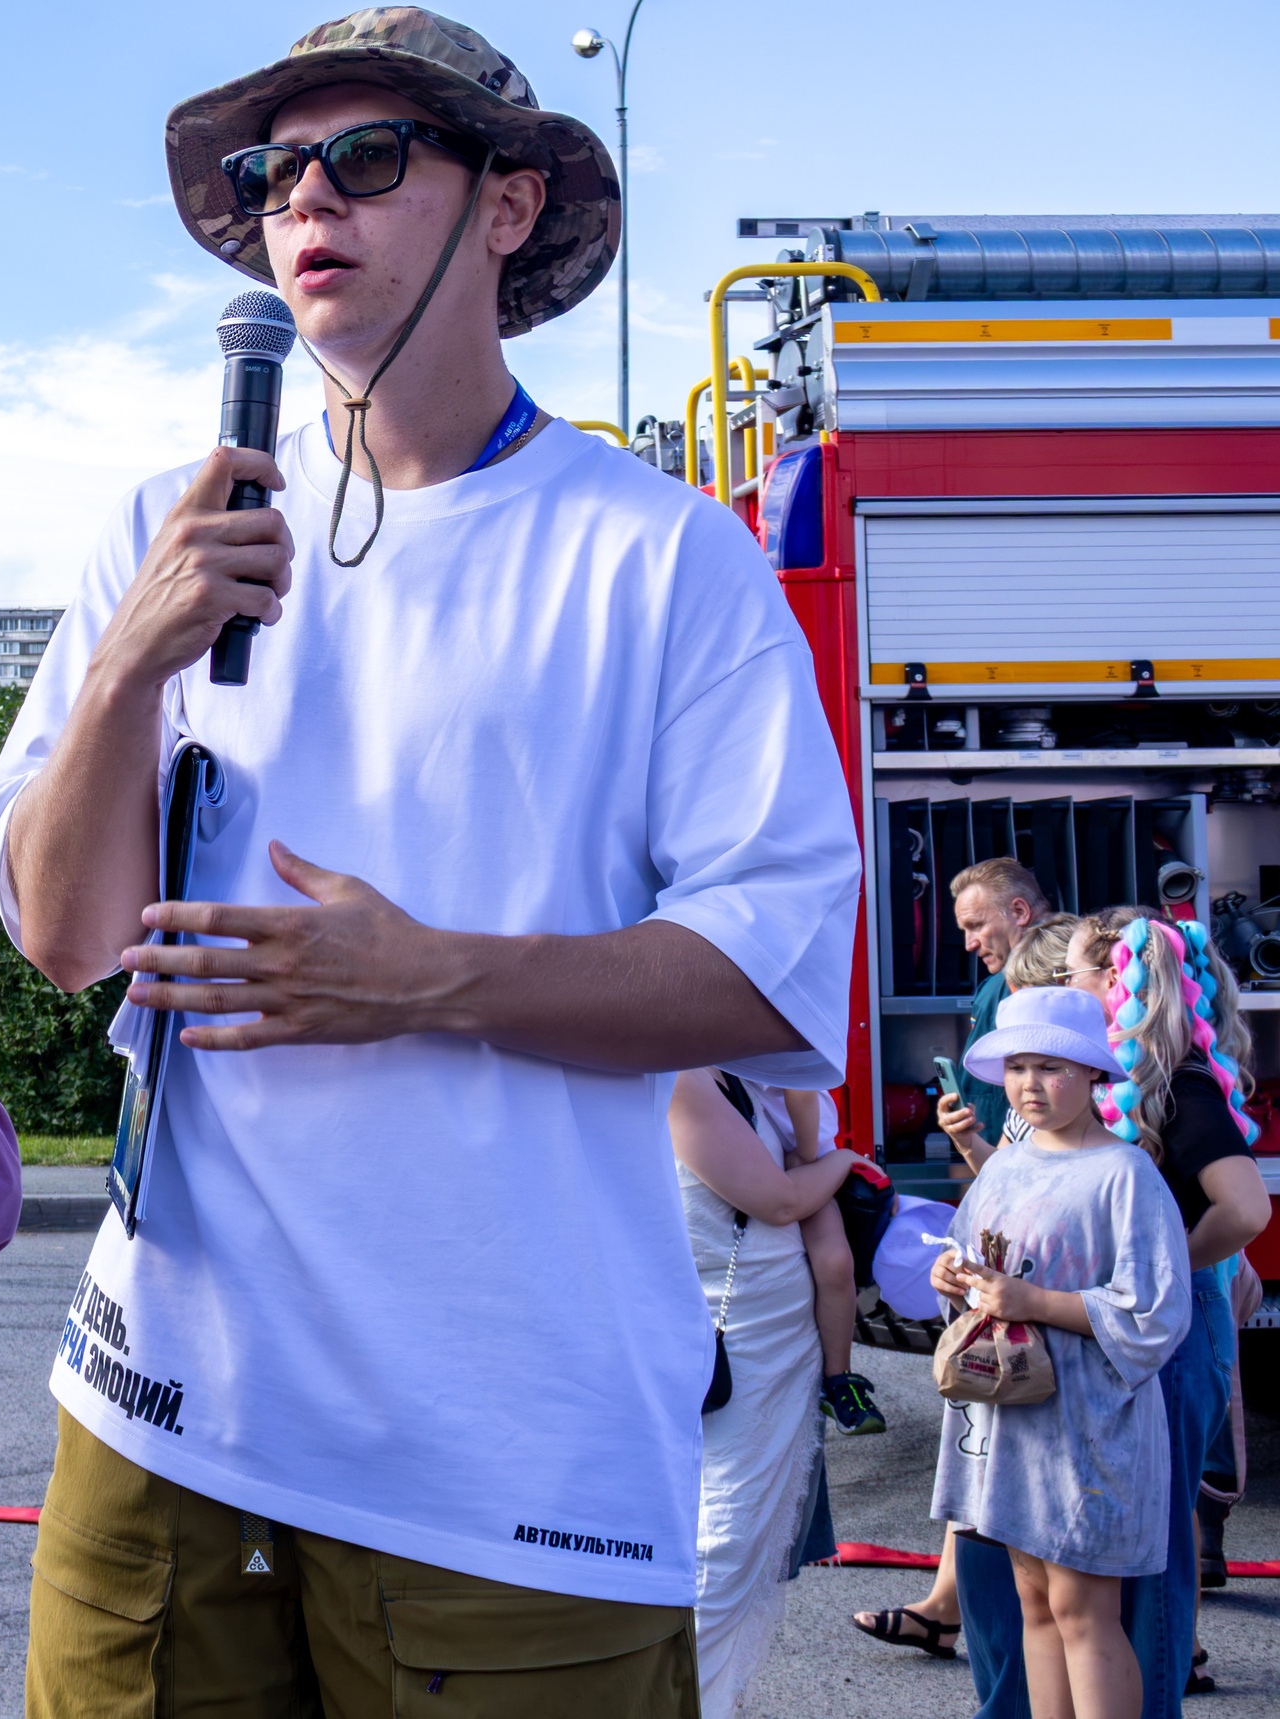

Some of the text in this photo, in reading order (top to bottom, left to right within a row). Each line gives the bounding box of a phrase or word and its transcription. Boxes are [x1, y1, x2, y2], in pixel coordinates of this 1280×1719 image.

[81, 1282, 130, 1356] ДЕНЬ.
[84, 1343, 184, 1436] ЭМОЦИЙ.
[513, 1524, 653, 1561] АВТОКУЛЬТУРА74
